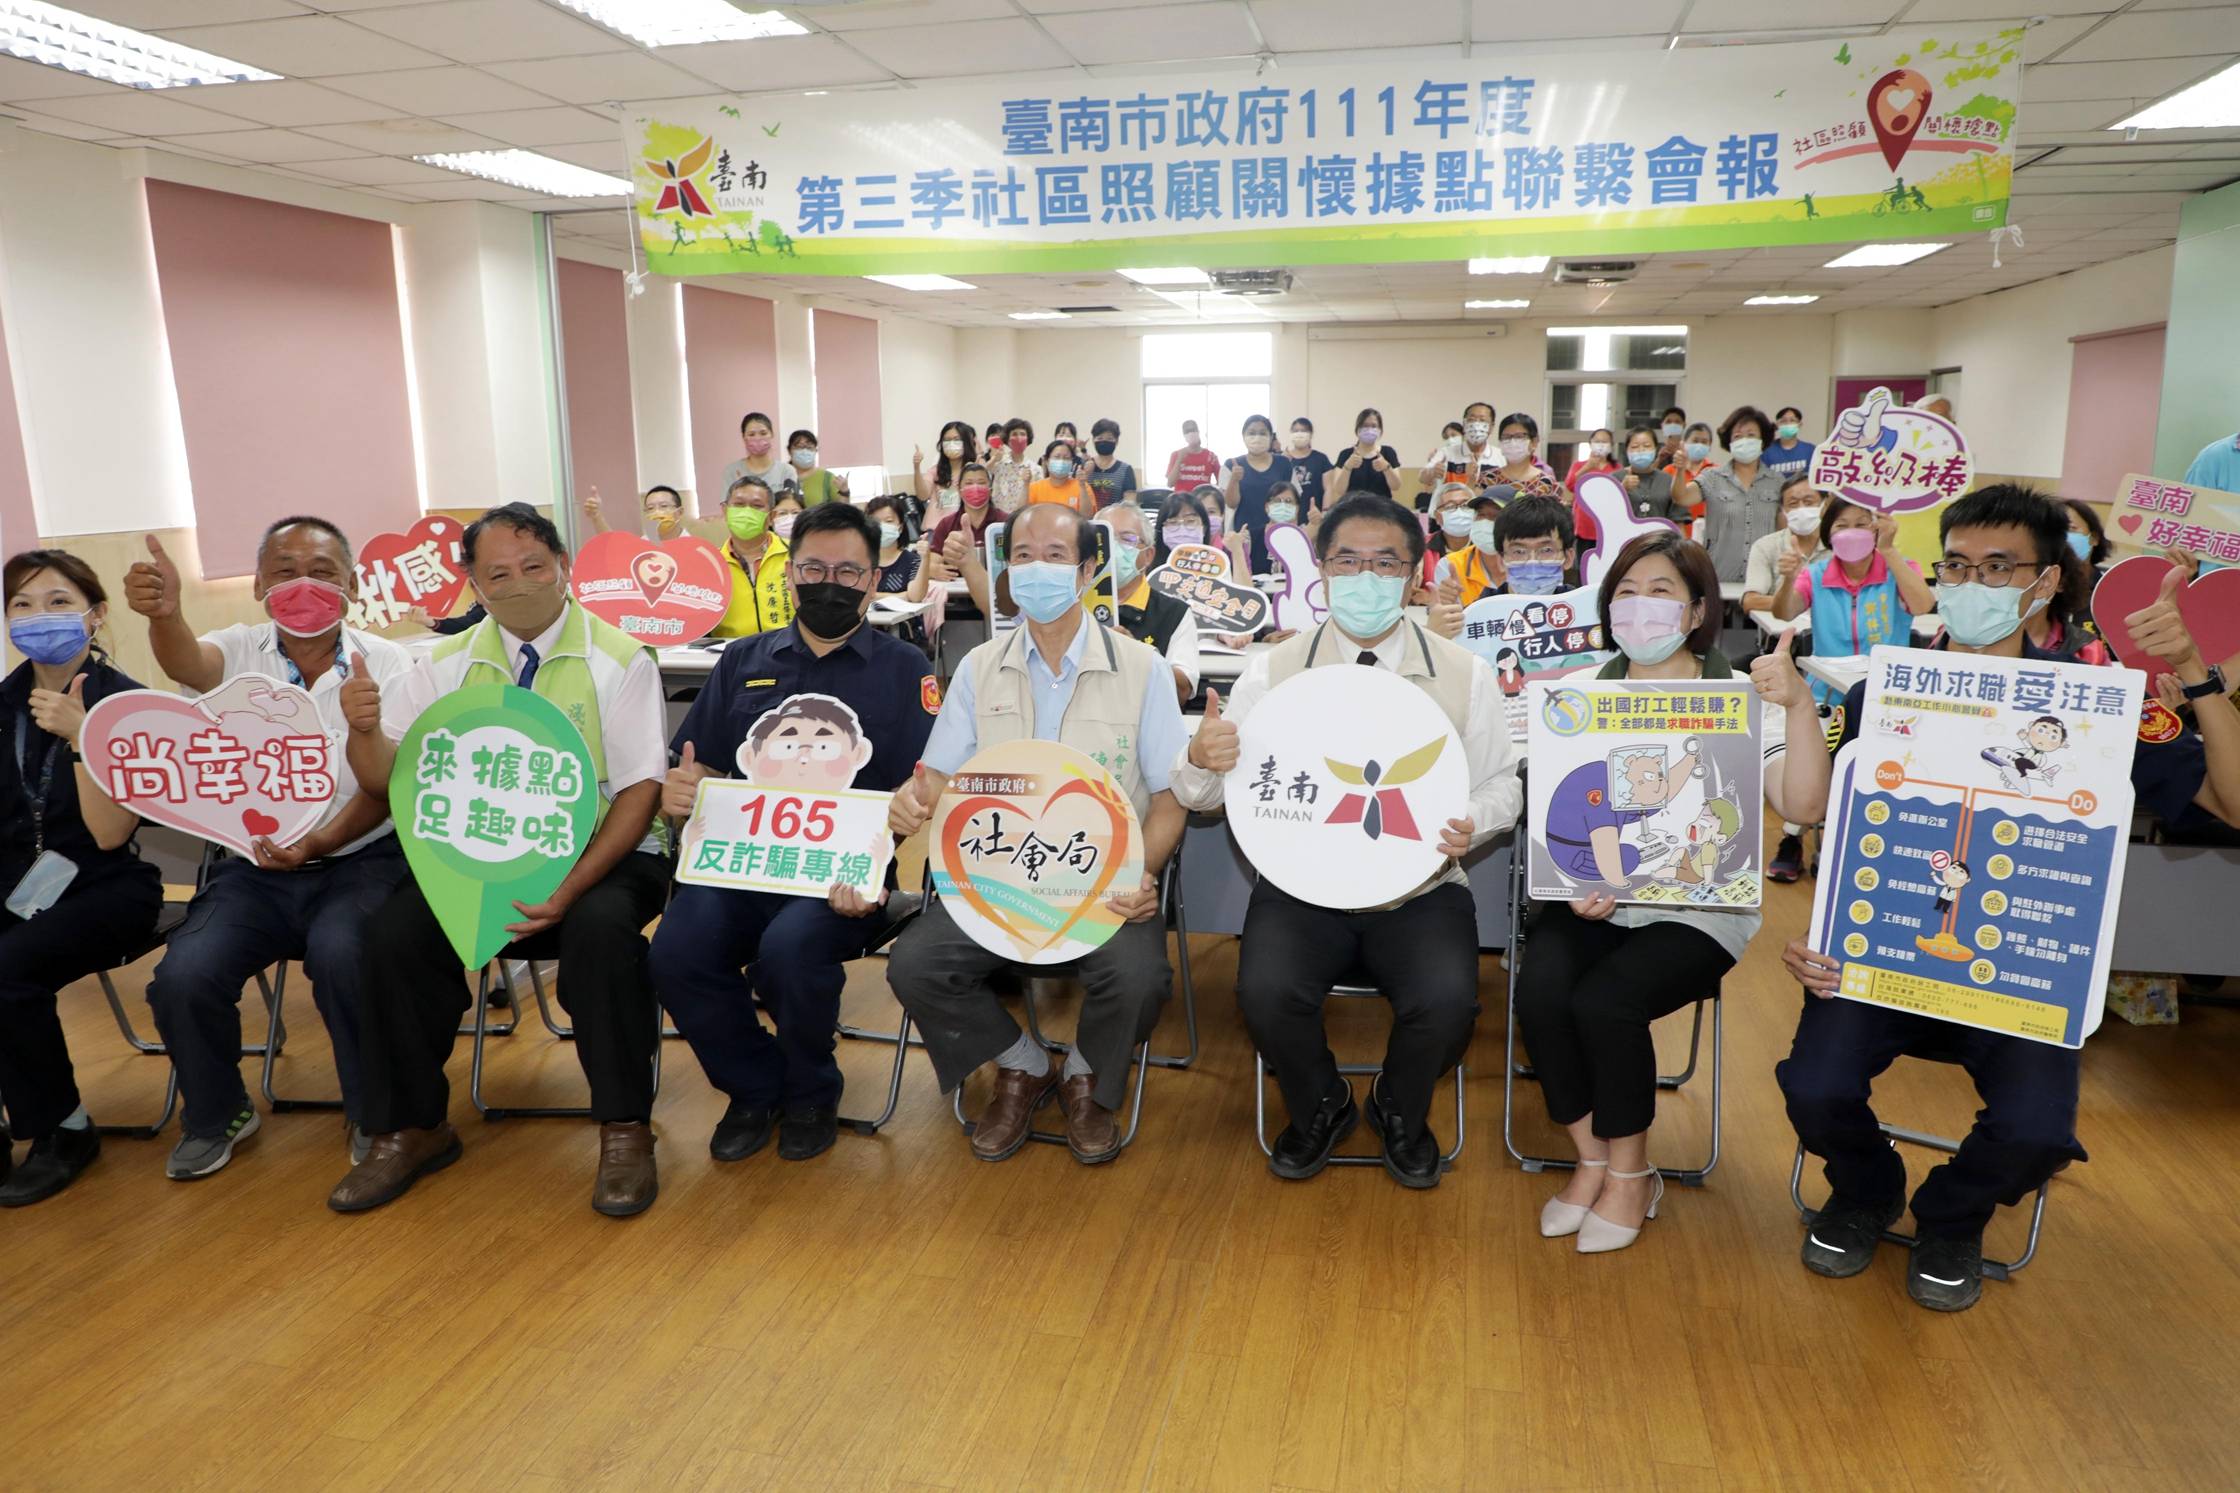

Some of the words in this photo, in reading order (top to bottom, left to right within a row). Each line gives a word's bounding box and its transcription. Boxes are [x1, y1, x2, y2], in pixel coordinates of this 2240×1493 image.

[1000, 75, 1536, 157] 臺南市政府111年度
[710, 149, 767, 192] 臺南
[795, 133, 1780, 234] 第三季社區照顧關懷據點聯繫會報
[716, 196, 764, 208] TAINAN
[1815, 446, 1967, 497] 敲級棒
[2127, 479, 2193, 516] 臺南
[2146, 518, 2240, 562] 好幸福
[345, 540, 461, 630] 揪感
[1466, 606, 1570, 640] 車輛慢看停
[1884, 663, 2127, 716] 海外求職愛注意
[108, 728, 335, 803] 尚幸福
[422, 732, 578, 798] 來據點
[957, 777, 1026, 793] 臺南市政府
[1249, 755, 1319, 804] 臺南
[740, 794, 838, 842] 165
[1254, 806, 1313, 822] TAINAN
[2071, 794, 2094, 811] Do
[694, 840, 873, 887] 反詐騙專線
[960, 812, 1098, 882] 社會局
[938, 879, 972, 891] TAINAN
[973, 881, 996, 895] CITY
[1031, 887, 1060, 897] SOCIAL
